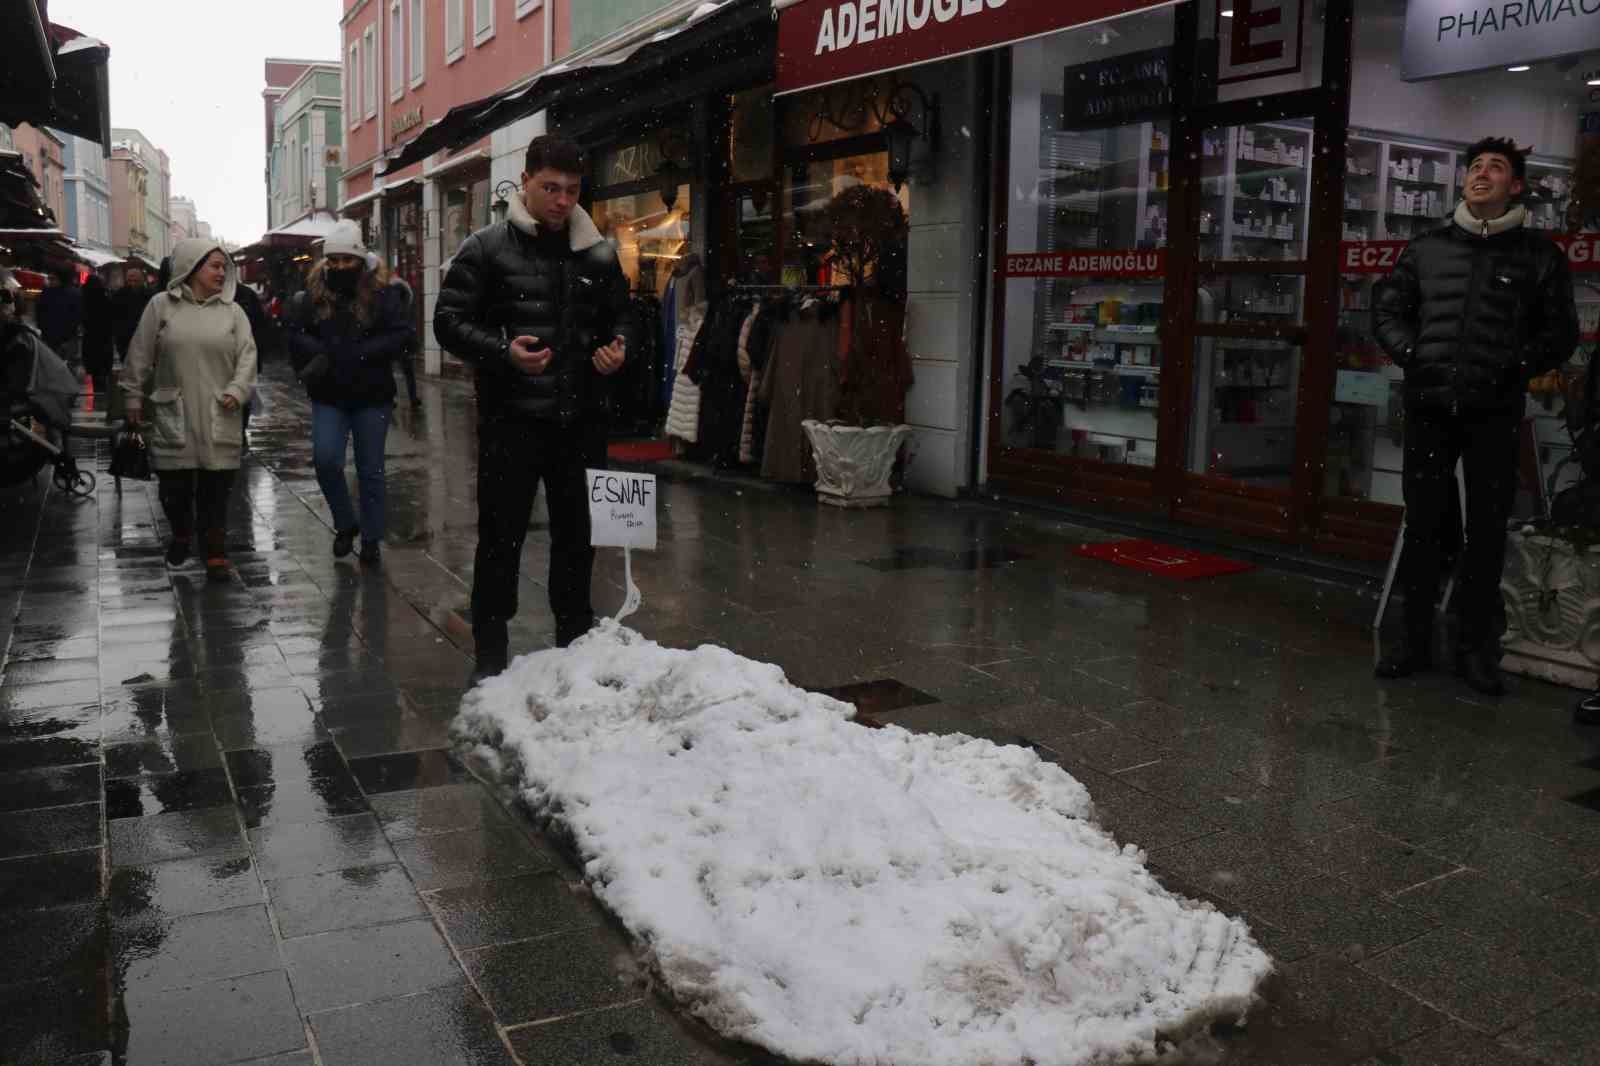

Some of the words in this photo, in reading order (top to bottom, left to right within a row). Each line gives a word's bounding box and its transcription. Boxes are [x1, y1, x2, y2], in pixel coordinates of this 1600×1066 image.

[814, 0, 1007, 56] ADEMO
[1007, 256, 1063, 273] ECZANE
[1068, 251, 1158, 272] ADEMOĞLU
[591, 475, 654, 507] ESNAF
